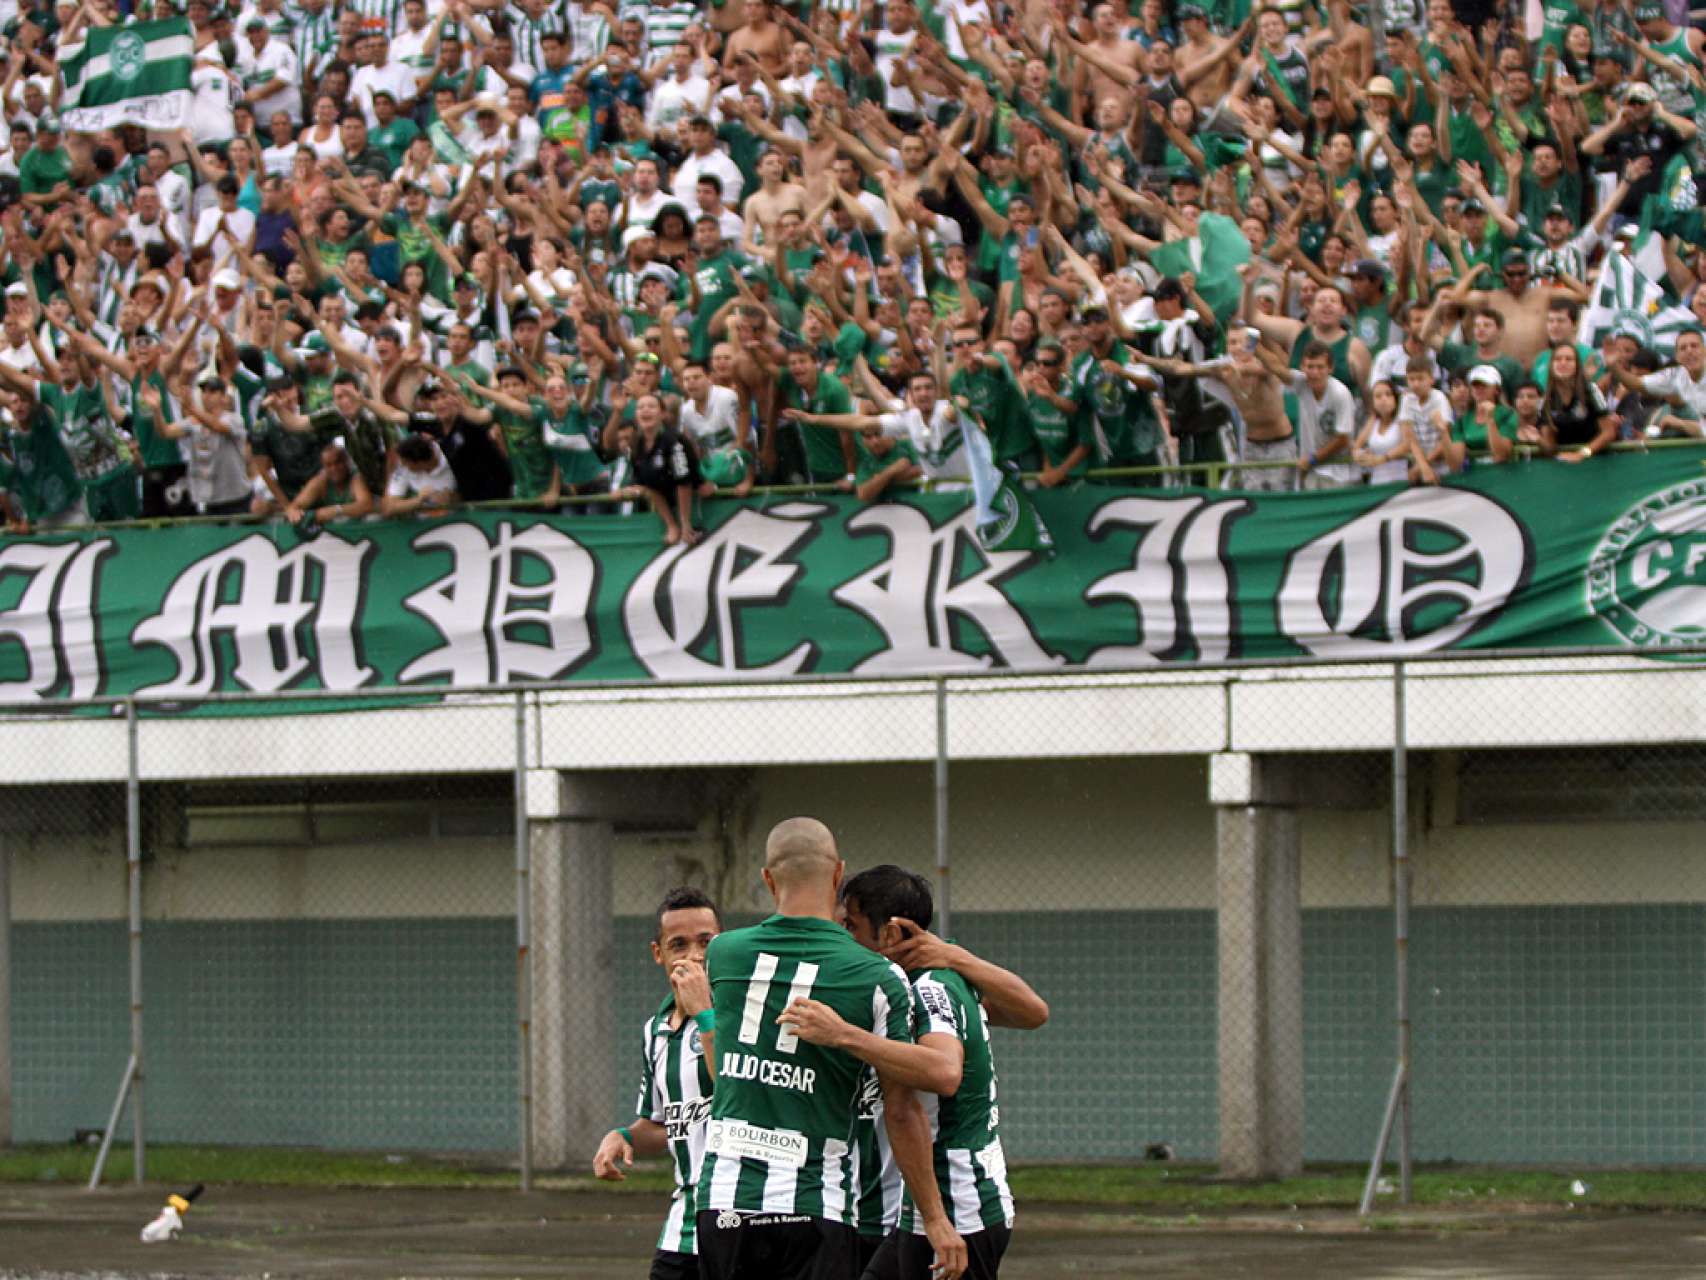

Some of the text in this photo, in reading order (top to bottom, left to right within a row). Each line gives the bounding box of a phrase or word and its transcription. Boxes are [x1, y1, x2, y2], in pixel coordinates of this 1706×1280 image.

[738, 953, 820, 1054] 11
[760, 1059, 816, 1094] CESAR
[729, 1126, 803, 1149] BOURBON
